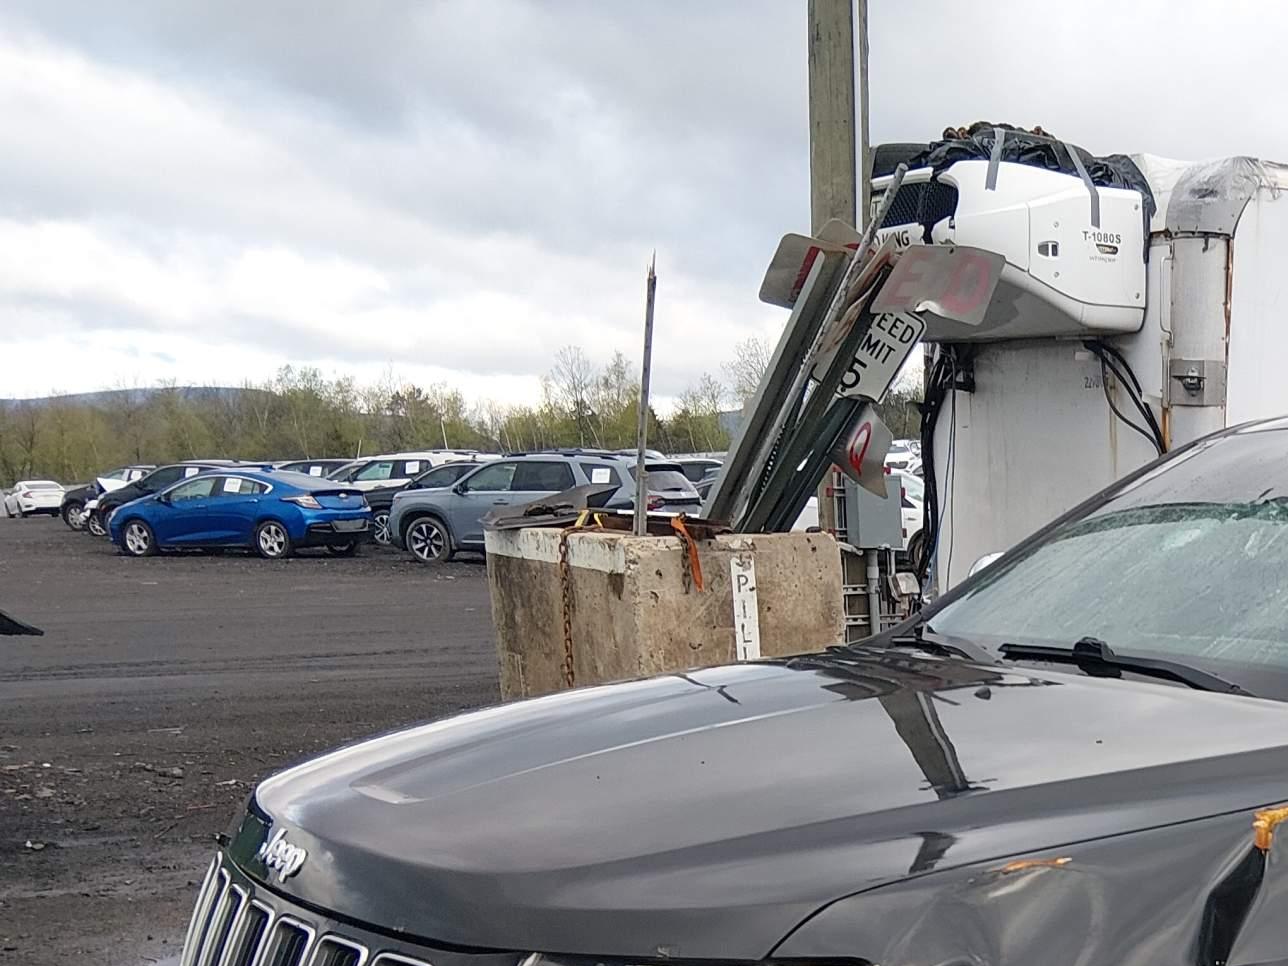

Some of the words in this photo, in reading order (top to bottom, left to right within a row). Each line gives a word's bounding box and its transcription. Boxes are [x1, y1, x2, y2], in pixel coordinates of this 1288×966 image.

[1081, 230, 1122, 245] T-1080S
[876, 313, 915, 344] EED
[861, 333, 896, 364] MIT
[259, 827, 308, 884] Jeep
